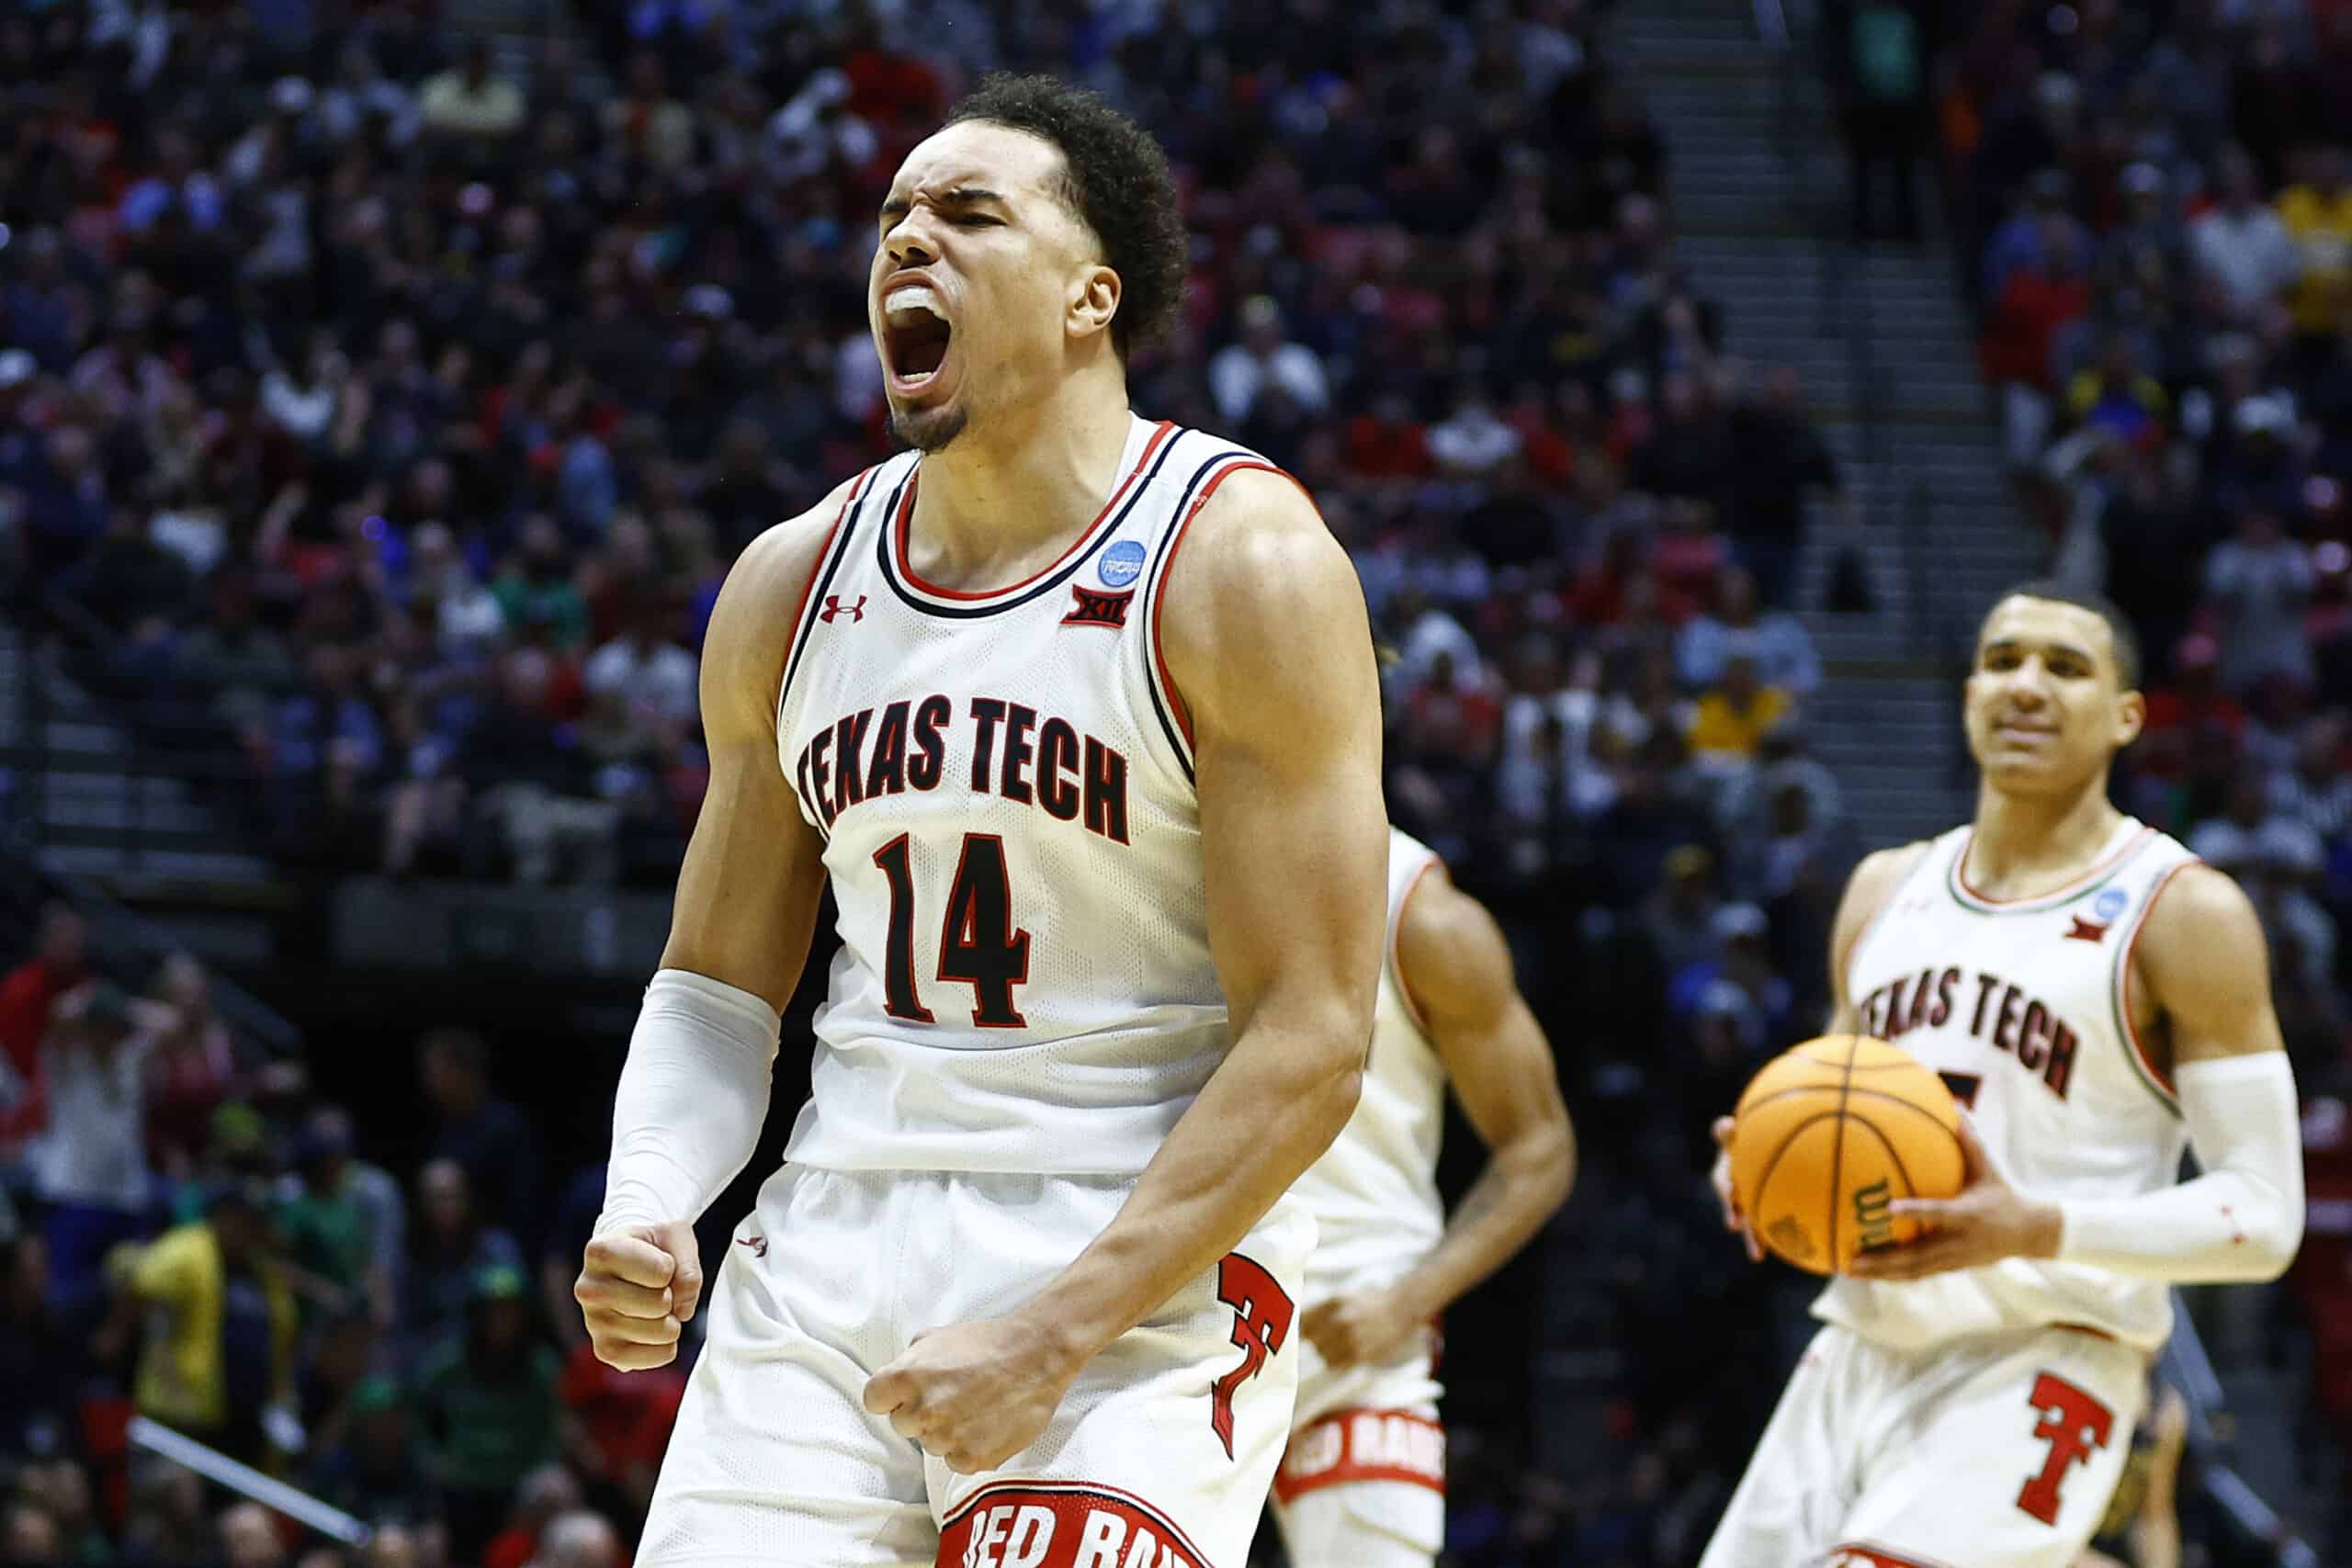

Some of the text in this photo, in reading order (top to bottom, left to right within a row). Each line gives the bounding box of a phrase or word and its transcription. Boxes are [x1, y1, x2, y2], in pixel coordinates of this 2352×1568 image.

[970, 696, 1130, 846] TECH
[873, 831, 1031, 1028] 14
[1970, 972, 2077, 1103] TECH
